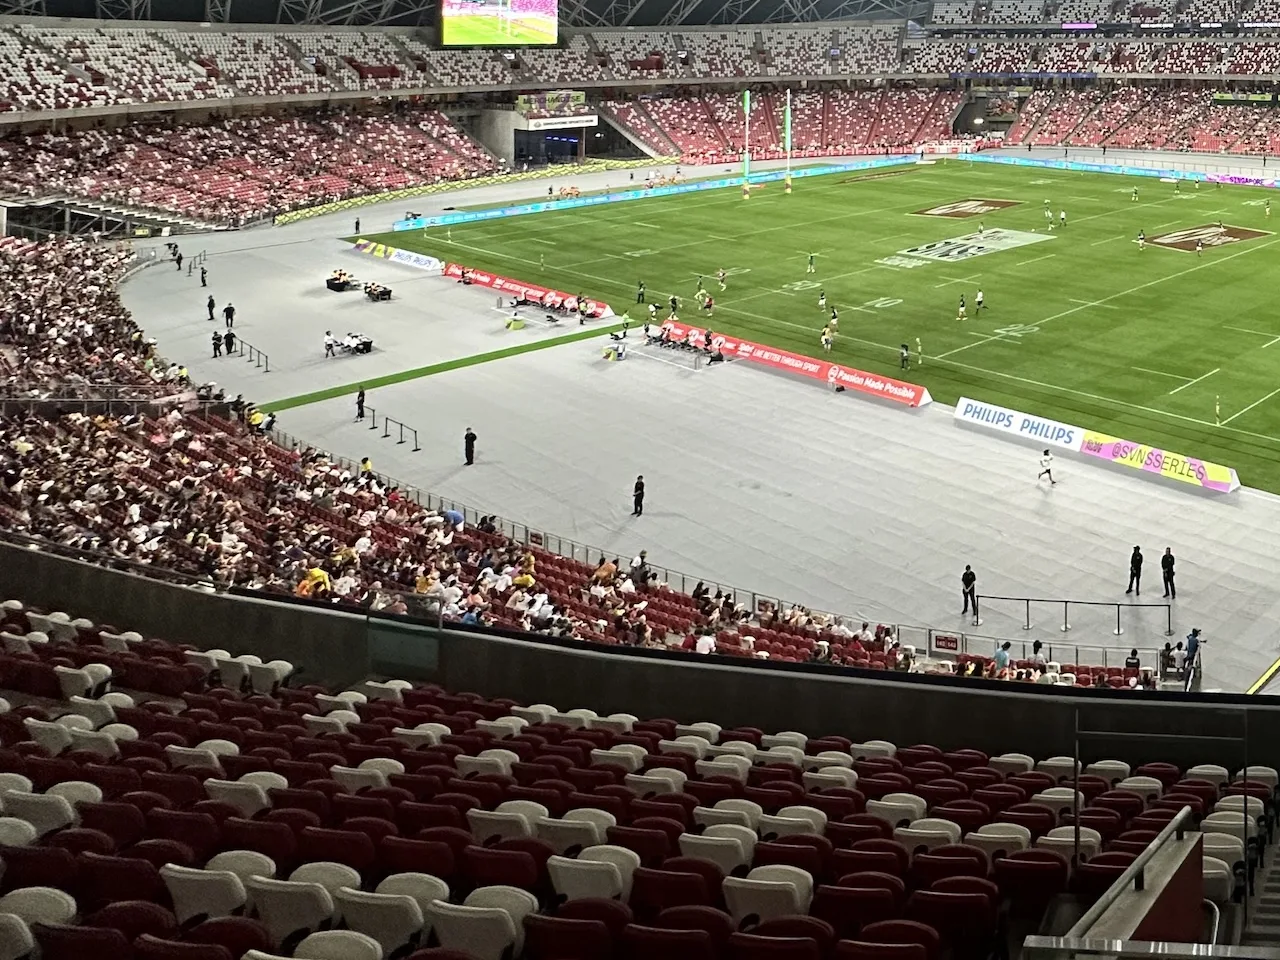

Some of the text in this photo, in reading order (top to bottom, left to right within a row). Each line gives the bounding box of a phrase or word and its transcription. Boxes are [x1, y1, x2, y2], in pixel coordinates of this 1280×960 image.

[1229, 176, 1265, 185] SINGAPORE
[763, 351, 782, 362] BETTER
[780, 355, 804, 368] THROUGH
[802, 361, 821, 373] SPORT
[837, 370, 916, 399] Passion Made Possible
[963, 403, 1075, 444] PHILIPS PHILIPS
[1111, 442, 1206, 481] @SVNSSERIES
